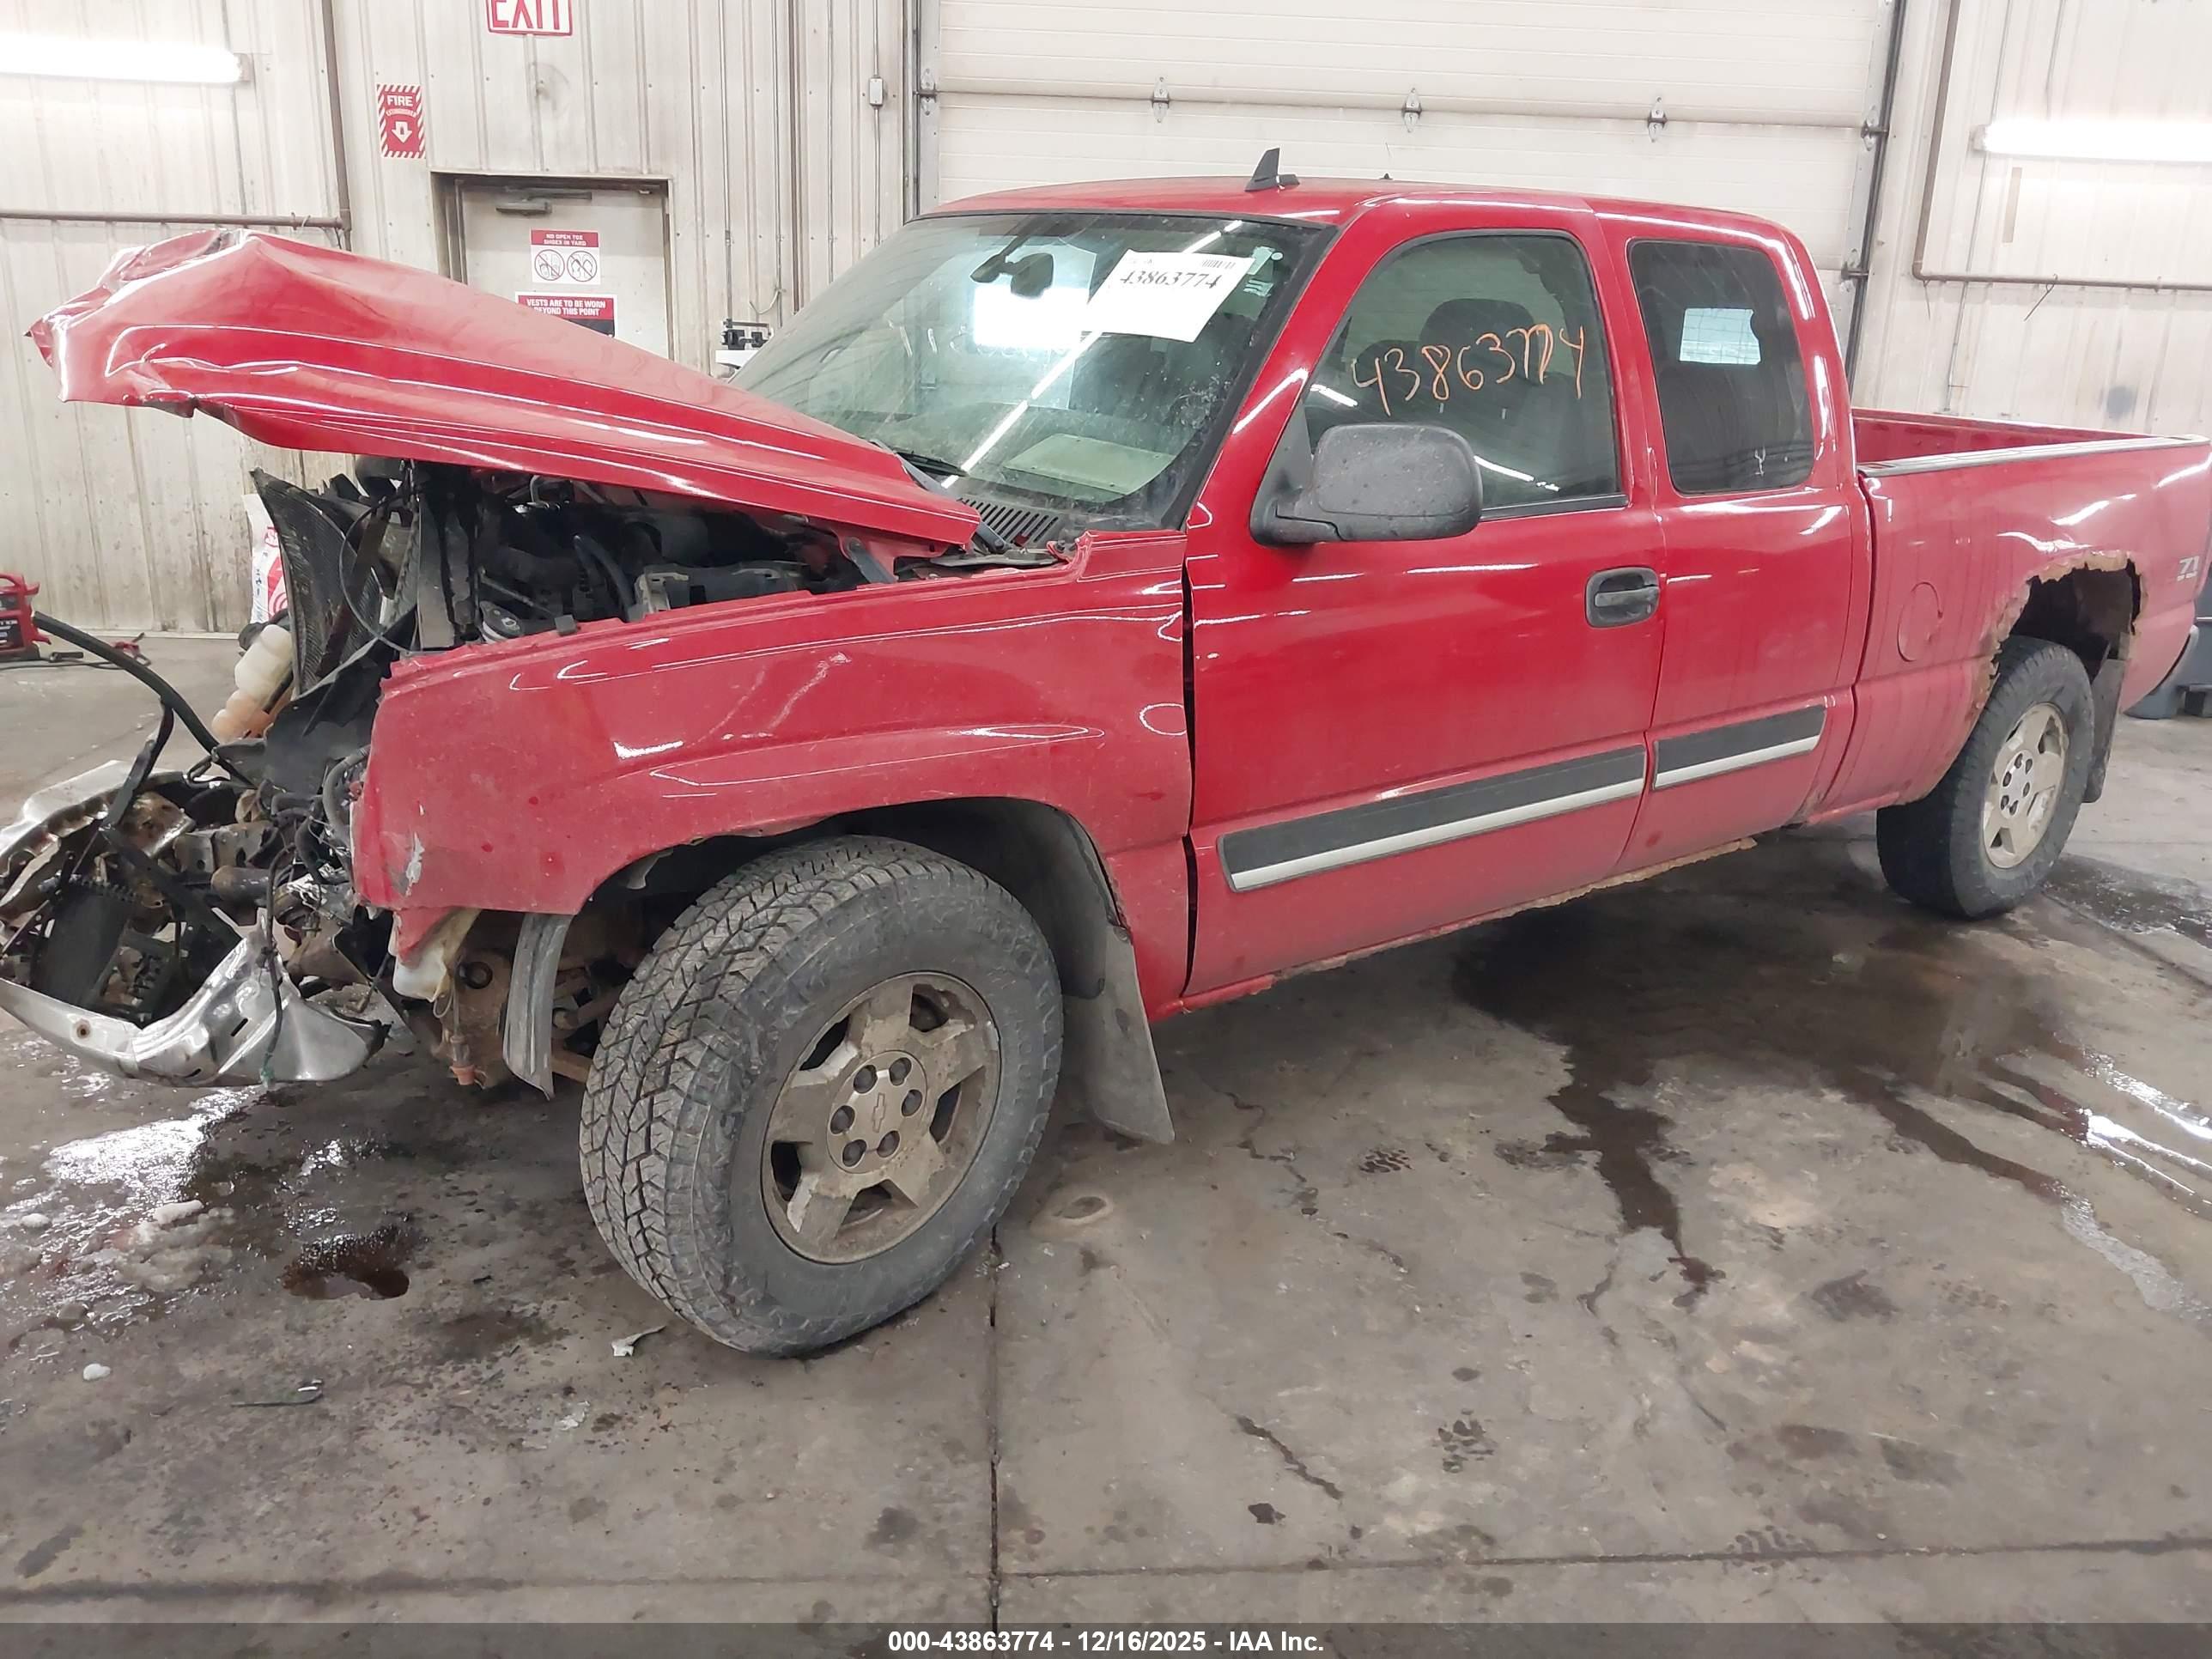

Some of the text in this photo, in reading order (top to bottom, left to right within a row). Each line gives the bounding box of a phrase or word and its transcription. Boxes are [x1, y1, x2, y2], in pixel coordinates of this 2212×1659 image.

[386, 94, 413, 106] FIRE
[1120, 270, 1223, 289] 43863774
[1351, 323, 1585, 416] 43863774
